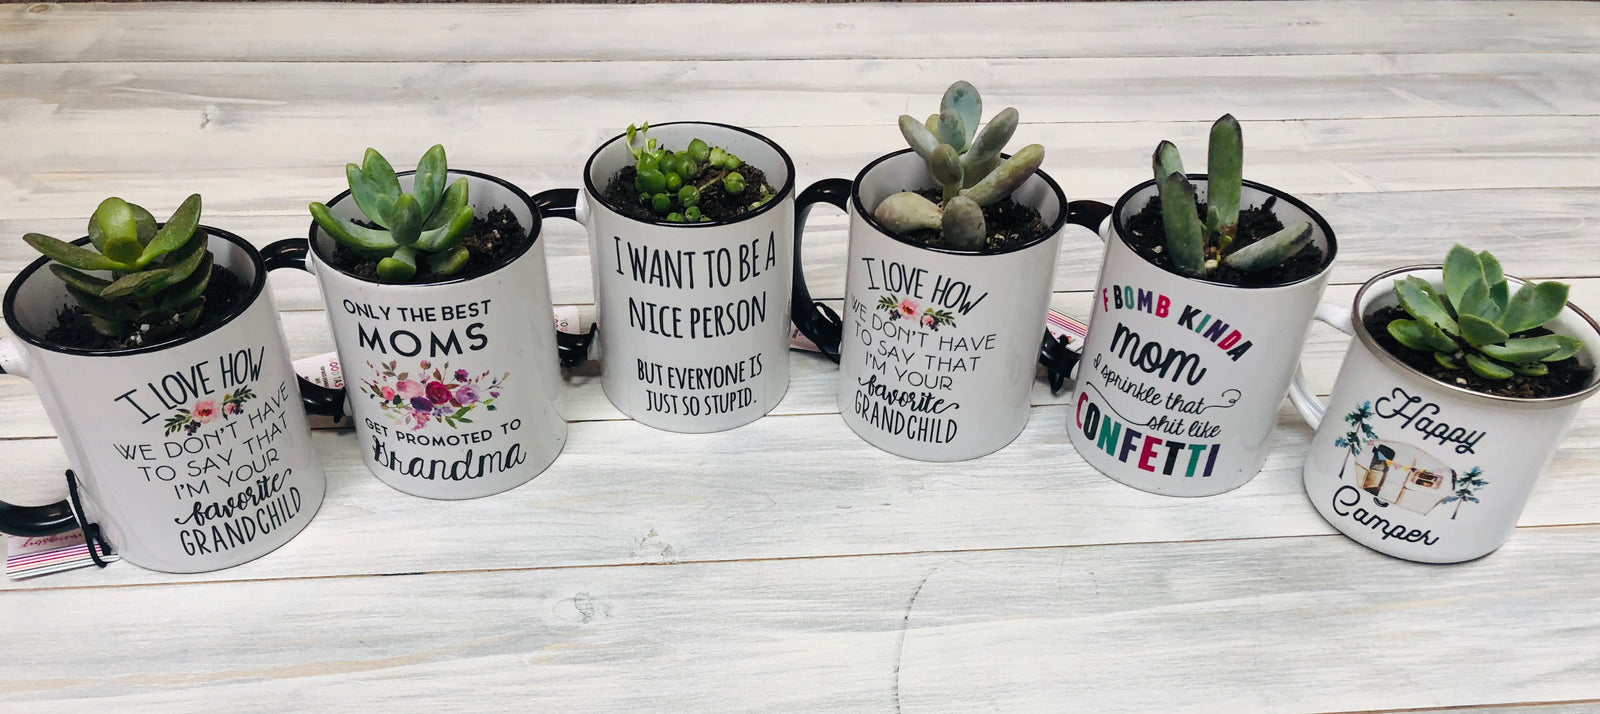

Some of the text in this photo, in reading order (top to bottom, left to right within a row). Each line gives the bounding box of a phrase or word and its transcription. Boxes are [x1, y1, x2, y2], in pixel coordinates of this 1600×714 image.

[614, 230, 776, 290] I WANT TO BE A
[862, 257, 988, 316] I LOVE HOW
[343, 299, 491, 322] ONLY THE BEST
[629, 291, 767, 340] NICE PERSON
[850, 292, 997, 352] WE DON'T HAVE
[1102, 284, 1253, 362] F BOMB KINDA
[358, 322, 488, 358] MOMS
[855, 320, 981, 373] TO SAY THAT
[1110, 322, 1207, 386] mom
[114, 346, 265, 425] I LOVE HOW
[637, 353, 762, 390] BUT EVERYONE IS
[858, 374, 960, 415] favorite
[865, 350, 953, 391] I'M YOUR
[1093, 353, 1101, 371] I
[1101, 364, 1163, 405] sprinkle
[113, 381, 289, 461] WE DON'T HAVE
[646, 387, 757, 416] JUST SO STUPID.
[855, 389, 958, 444] GRANDCHILD
[1146, 415, 1221, 438] shit like
[1375, 387, 1486, 454] Happy
[138, 411, 288, 482] TO SAY THAT
[365, 417, 521, 447] GET PROMOTED TO
[372, 435, 527, 482] Grandma
[1075, 392, 1221, 478] CONFETTI
[174, 448, 279, 500] I'M YOUR
[175, 468, 292, 526] favorite
[180, 486, 301, 556] GRANDCHILD
[1332, 485, 1440, 546] Camper
